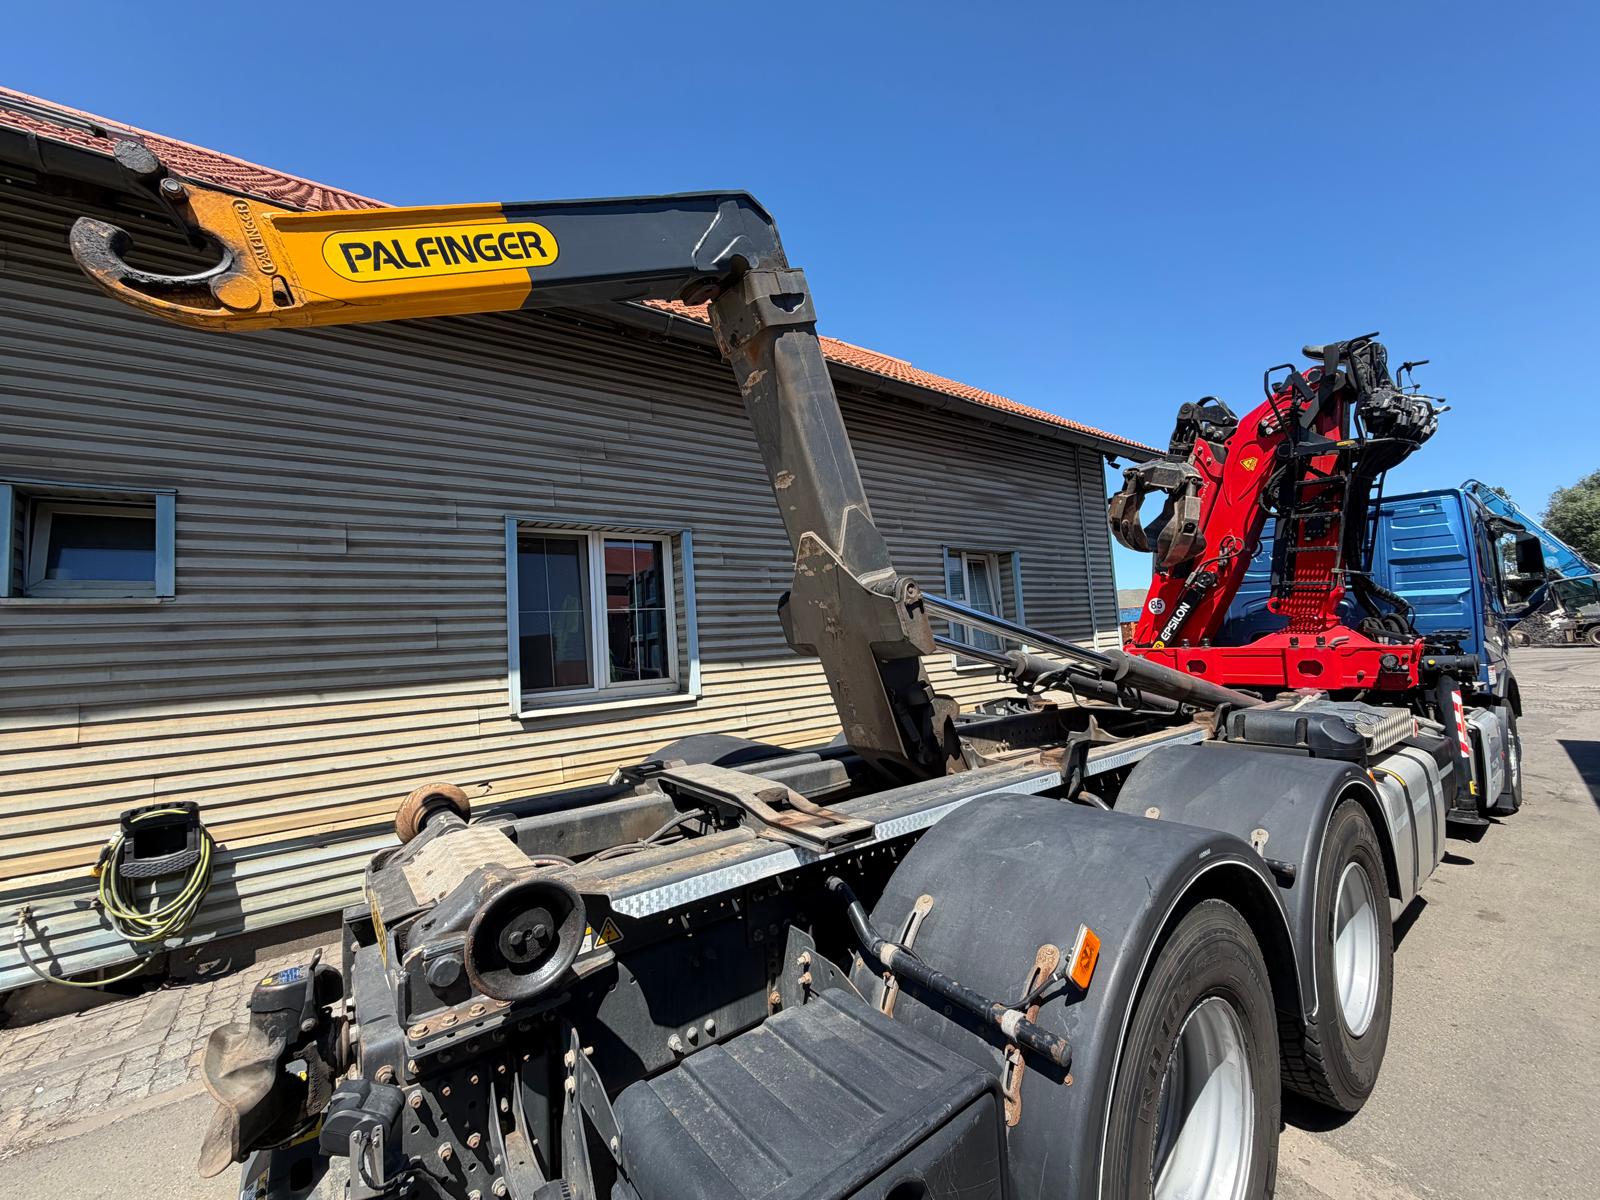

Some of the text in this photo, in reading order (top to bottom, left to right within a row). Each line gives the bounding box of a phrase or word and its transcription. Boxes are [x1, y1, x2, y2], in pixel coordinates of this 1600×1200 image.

[339, 231, 548, 273] PALFINGER
[1150, 599, 1163, 610] 85
[1161, 602, 1191, 641] EPSILON
